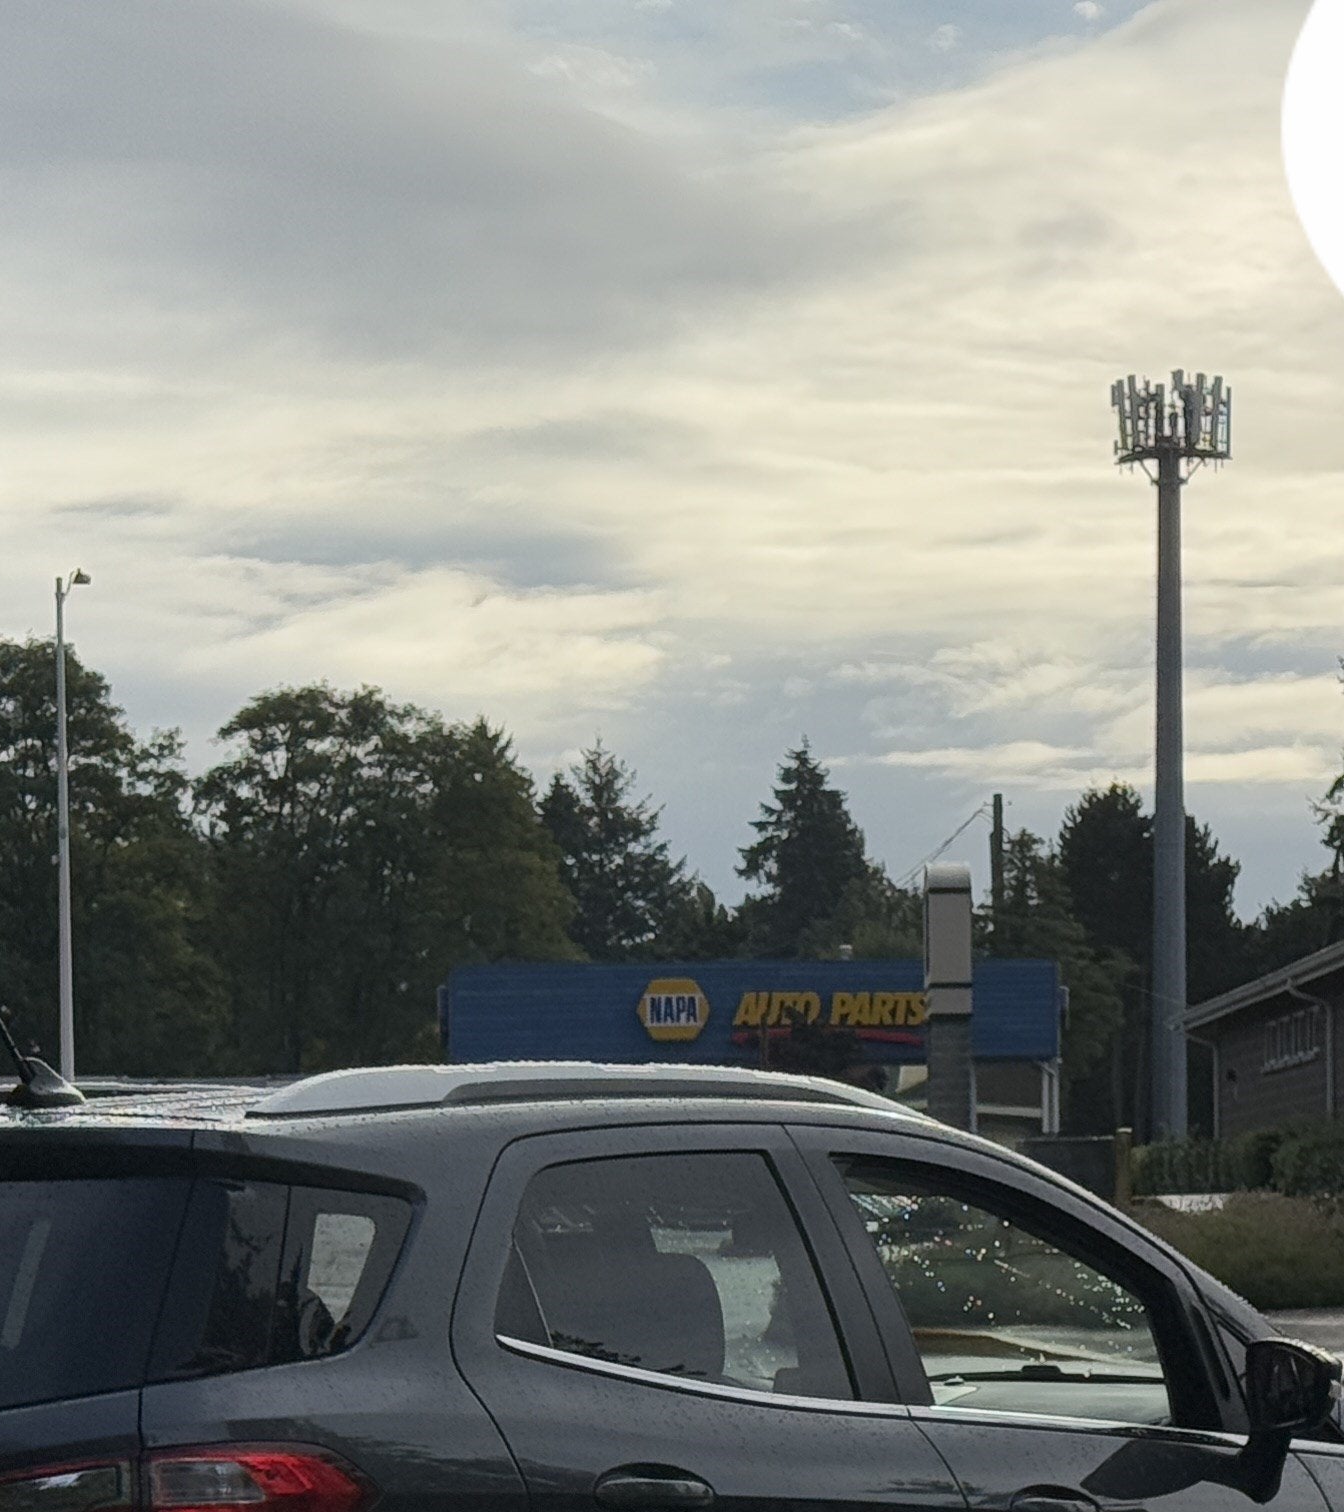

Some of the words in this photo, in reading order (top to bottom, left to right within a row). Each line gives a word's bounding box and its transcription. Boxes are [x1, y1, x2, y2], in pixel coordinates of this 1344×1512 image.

[649, 996, 699, 1024] NAPA
[732, 990, 822, 1026] AUTO
[829, 990, 926, 1026] PARTS
